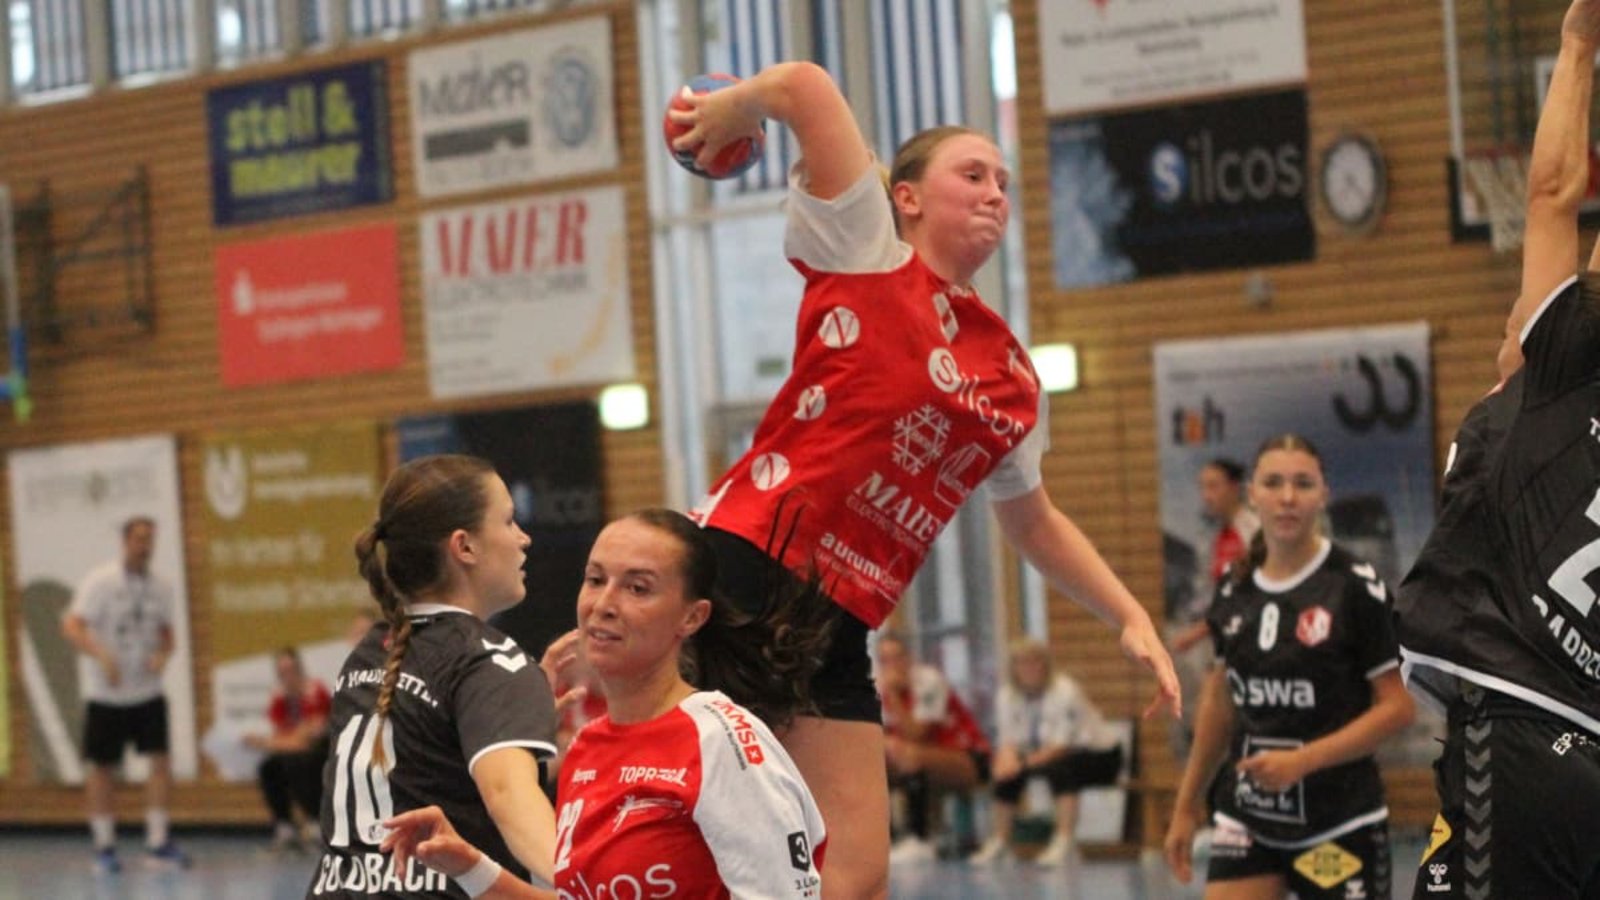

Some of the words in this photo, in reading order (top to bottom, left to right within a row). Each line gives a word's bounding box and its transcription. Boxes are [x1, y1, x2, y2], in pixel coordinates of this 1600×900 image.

[1258, 602, 1280, 651] 8
[1248, 678, 1316, 709] swa
[329, 711, 398, 848] 10
